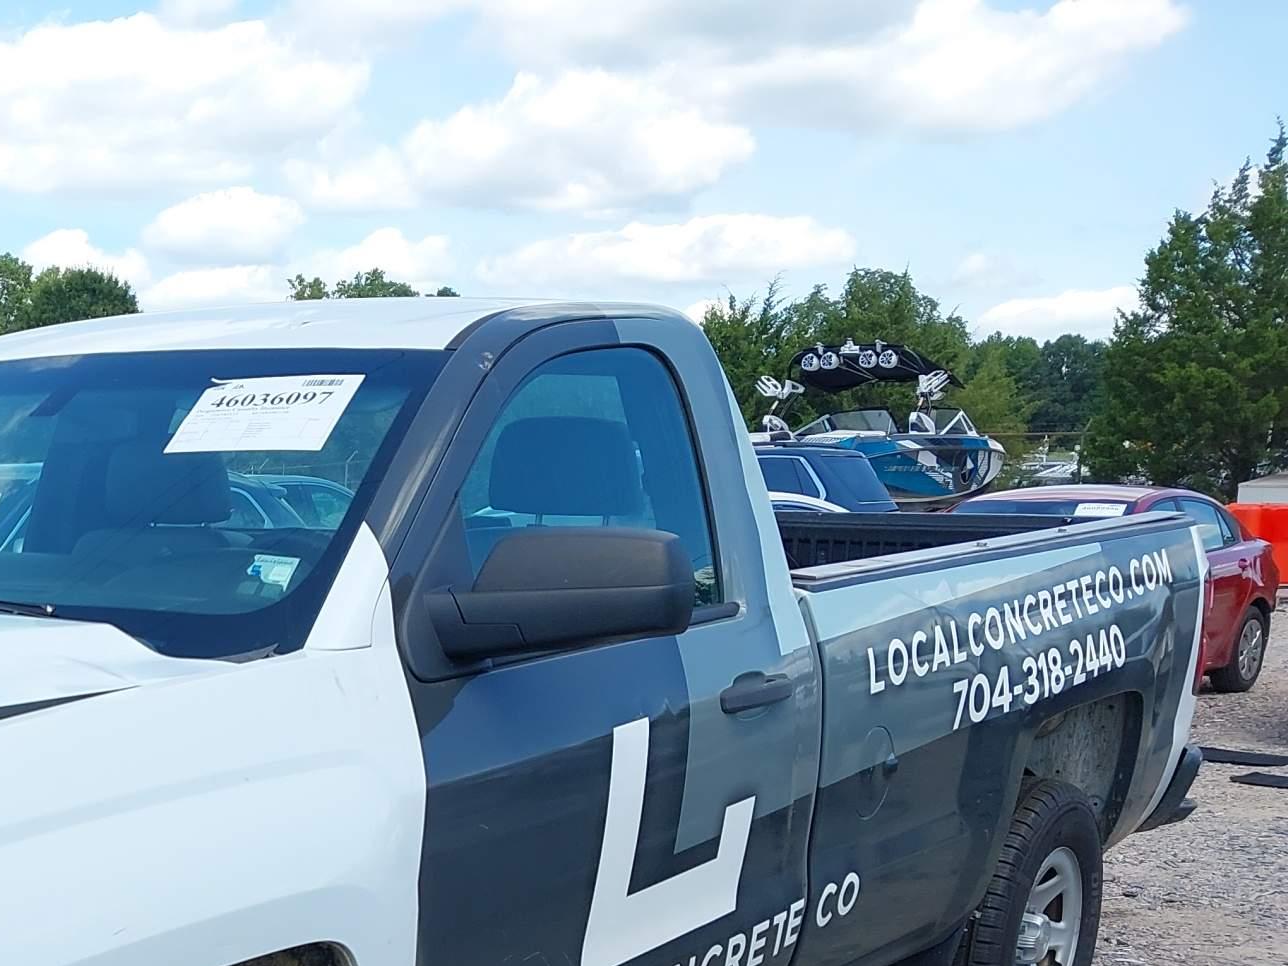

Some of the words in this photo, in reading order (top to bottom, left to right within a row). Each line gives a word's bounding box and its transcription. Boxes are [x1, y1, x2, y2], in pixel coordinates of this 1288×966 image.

[211, 390, 334, 409] 46036097
[867, 548, 1173, 695] LOCALCONCRETECO.COM
[952, 624, 1127, 730] 704-318-2440
[816, 871, 862, 927] CO
